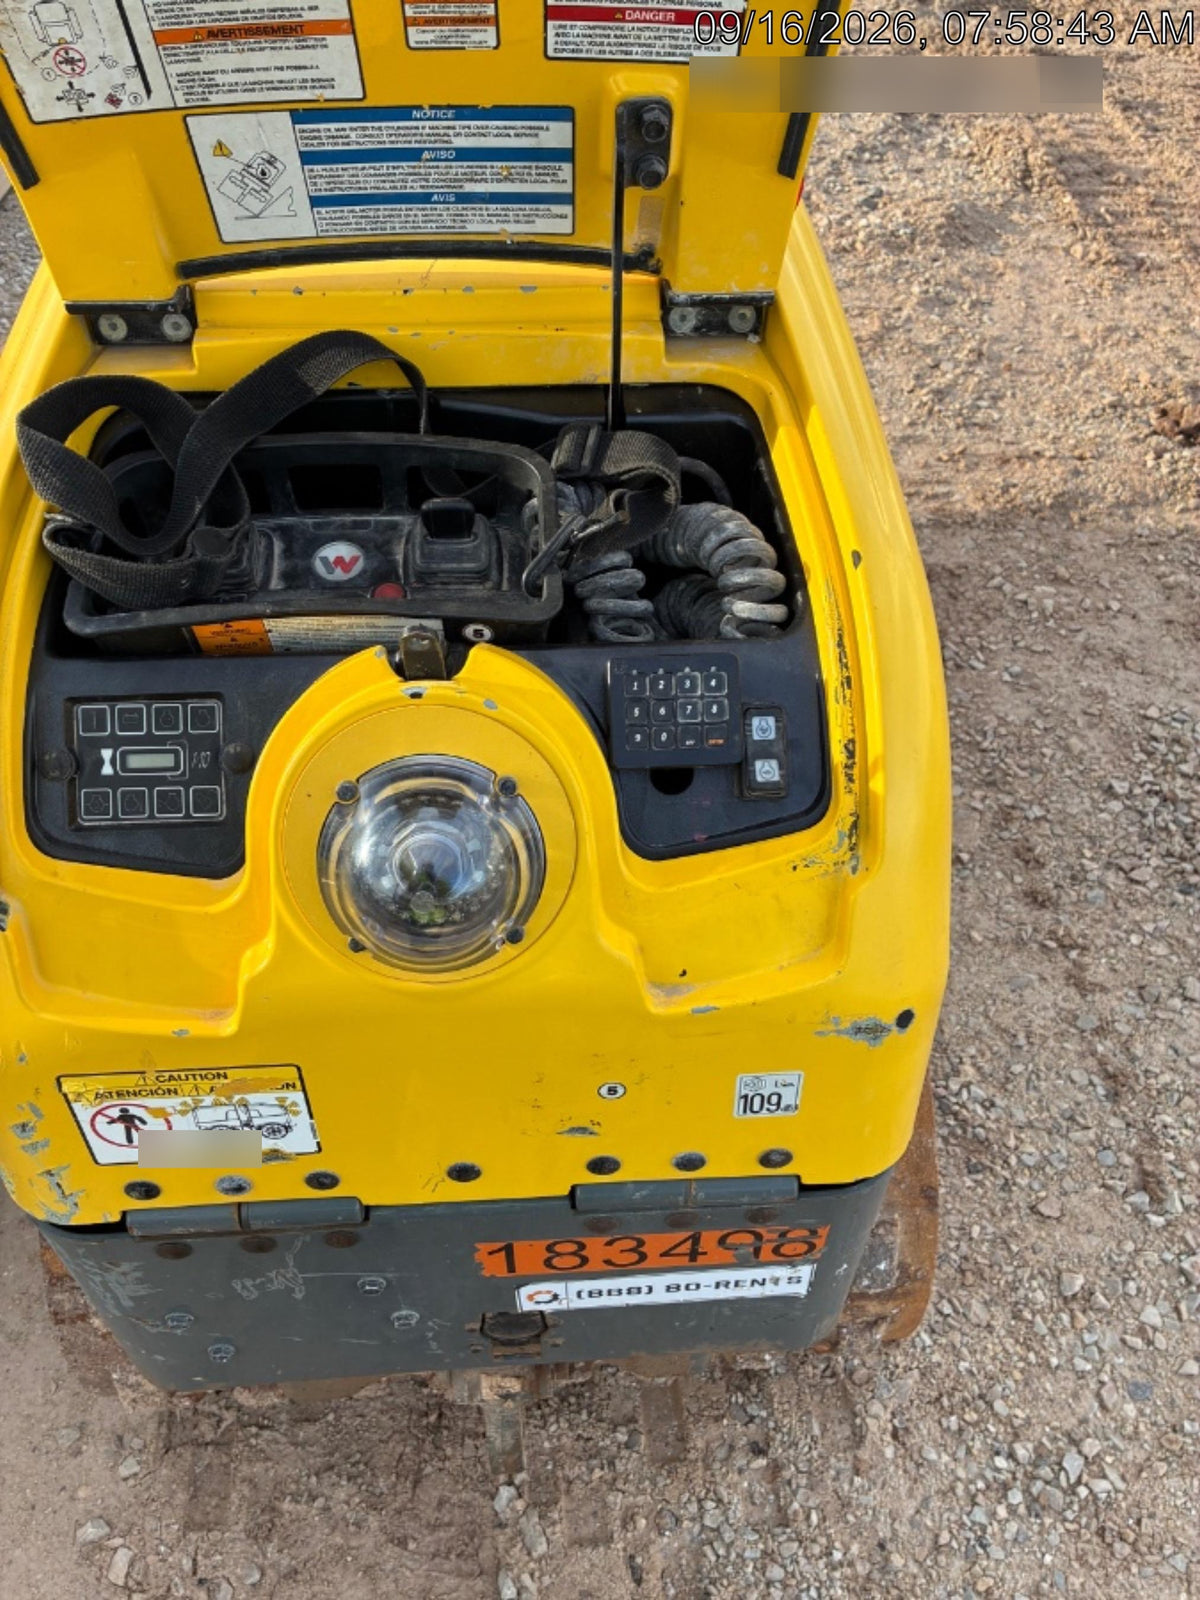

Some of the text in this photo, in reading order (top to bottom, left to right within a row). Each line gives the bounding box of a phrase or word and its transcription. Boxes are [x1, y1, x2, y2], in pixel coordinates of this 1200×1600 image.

[625, 10, 676, 21] DANGER
[206, 24, 304, 38] AVERTISSEMENT
[412, 110, 456, 119] NOTICE
[422, 150, 456, 160] AVISO
[633, 682, 638, 690] 1
[659, 681, 664, 689] 2
[684, 679, 690, 688] 3
[634, 707, 640, 717] 5
[659, 706, 666, 715] 6
[686, 705, 692, 715] 7
[661, 732, 667, 742] 0
[155, 1072, 228, 1083] CAUTION
[607, 1086, 618, 1096] 5
[740, 1092, 782, 1114] 109
[487, 1228, 822, 1274] 183498
[576, 1285, 653, 1299] (888)
